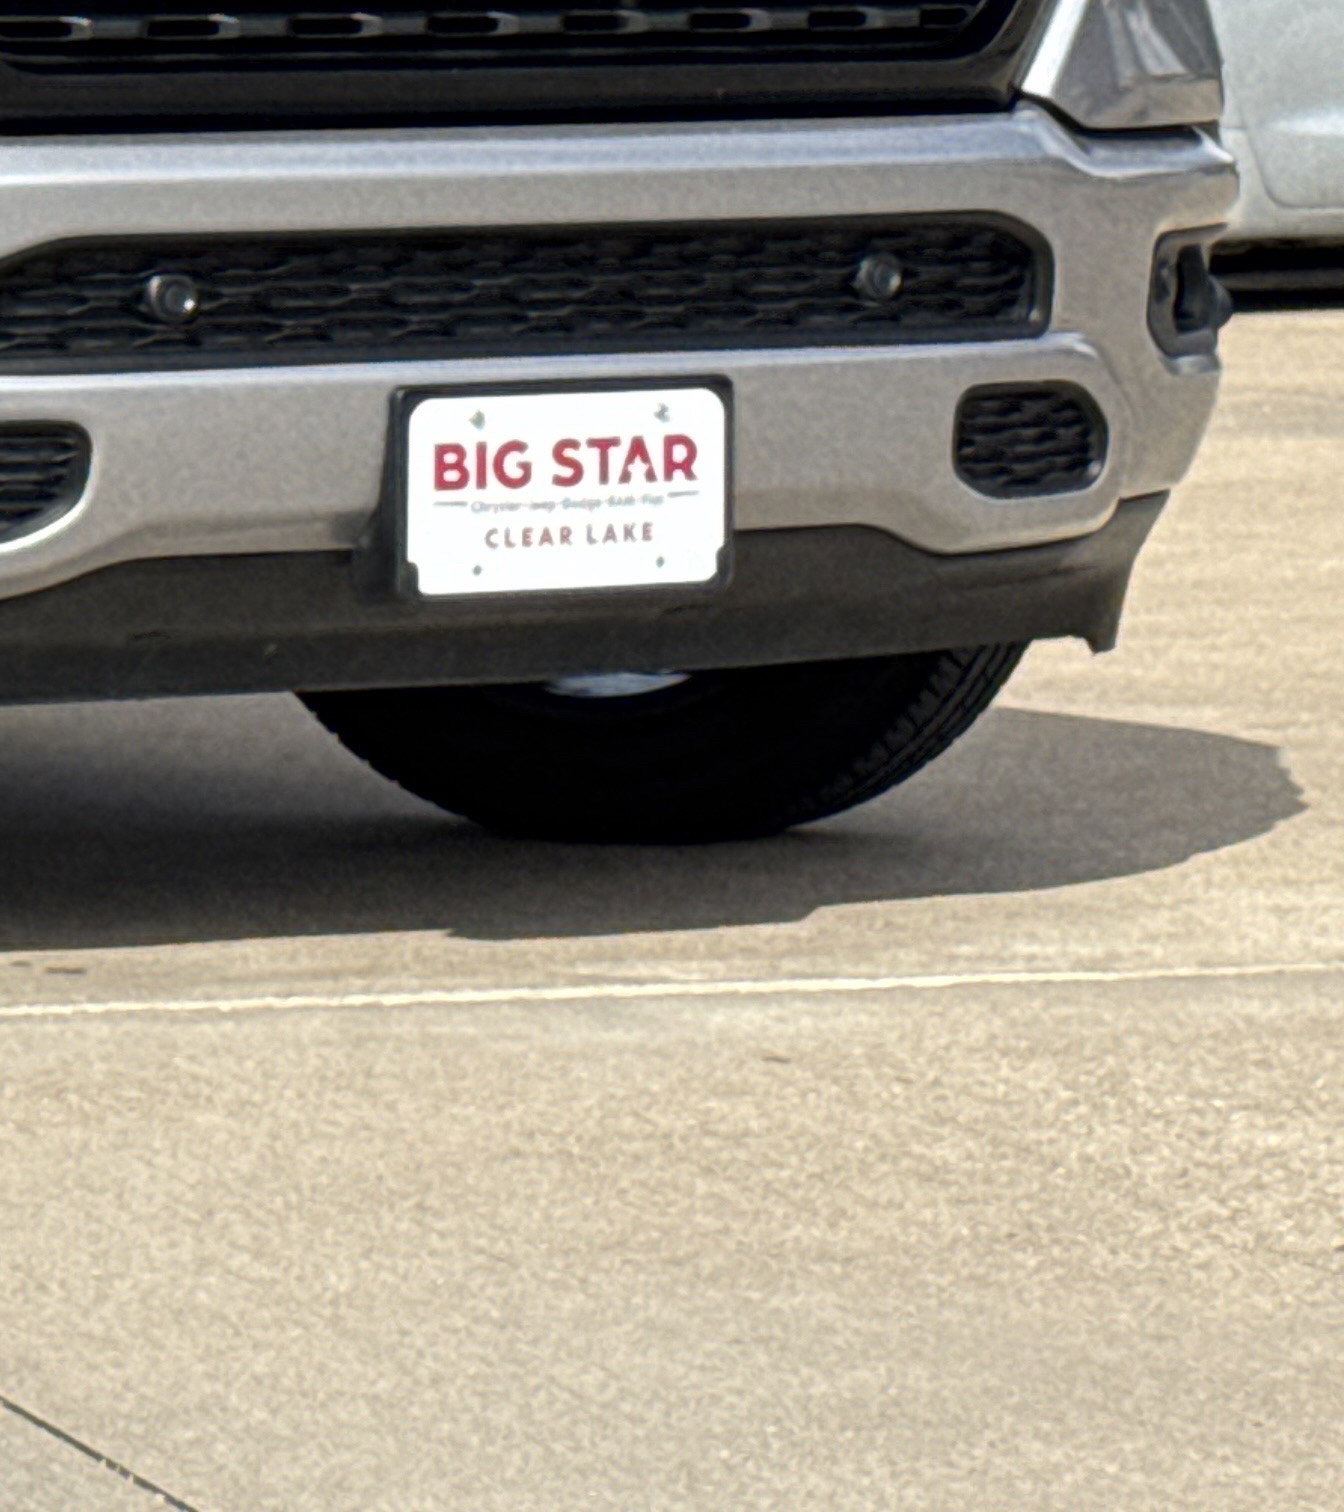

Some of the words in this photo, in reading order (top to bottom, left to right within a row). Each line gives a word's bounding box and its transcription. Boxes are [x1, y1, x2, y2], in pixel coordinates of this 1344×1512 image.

[434, 440, 532, 490] BIG
[552, 435, 698, 486] STAR
[484, 524, 573, 549] CLEAR
[586, 521, 654, 545] LAKE
